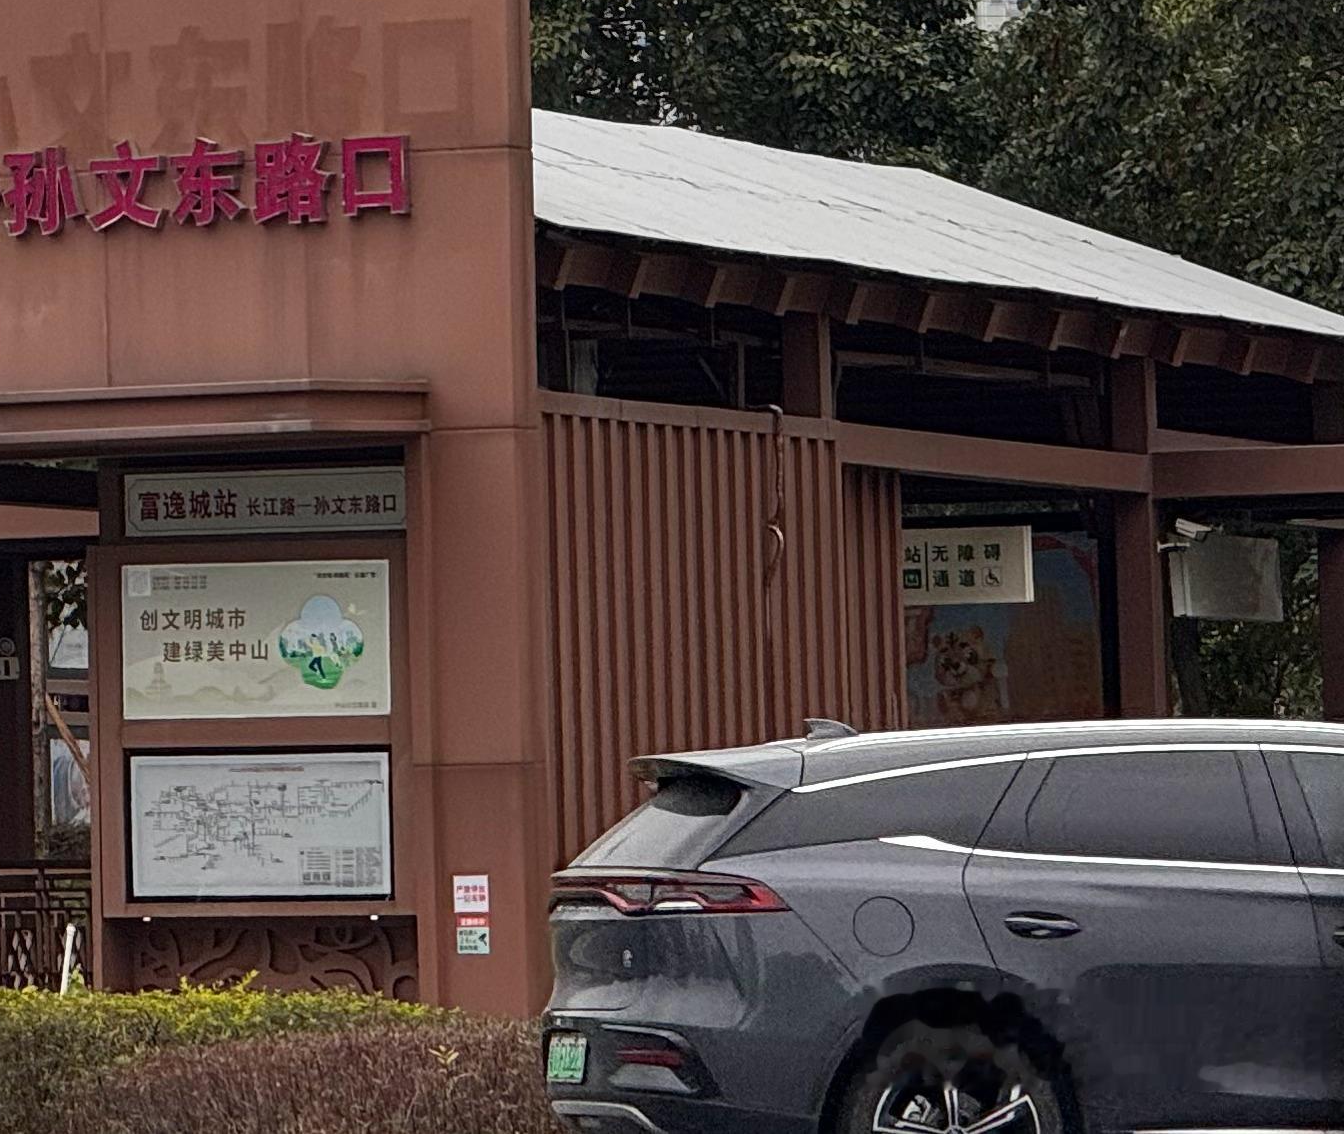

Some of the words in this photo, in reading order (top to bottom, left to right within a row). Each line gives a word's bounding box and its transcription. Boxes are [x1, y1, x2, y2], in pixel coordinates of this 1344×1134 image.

[138, 489, 238, 521] 富逸城站
[932, 544, 1001, 562] 无障碍
[933, 569, 975, 587] 通道
[139, 608, 247, 631] 创文明城市
[162, 640, 269, 663] 建绿美中山
